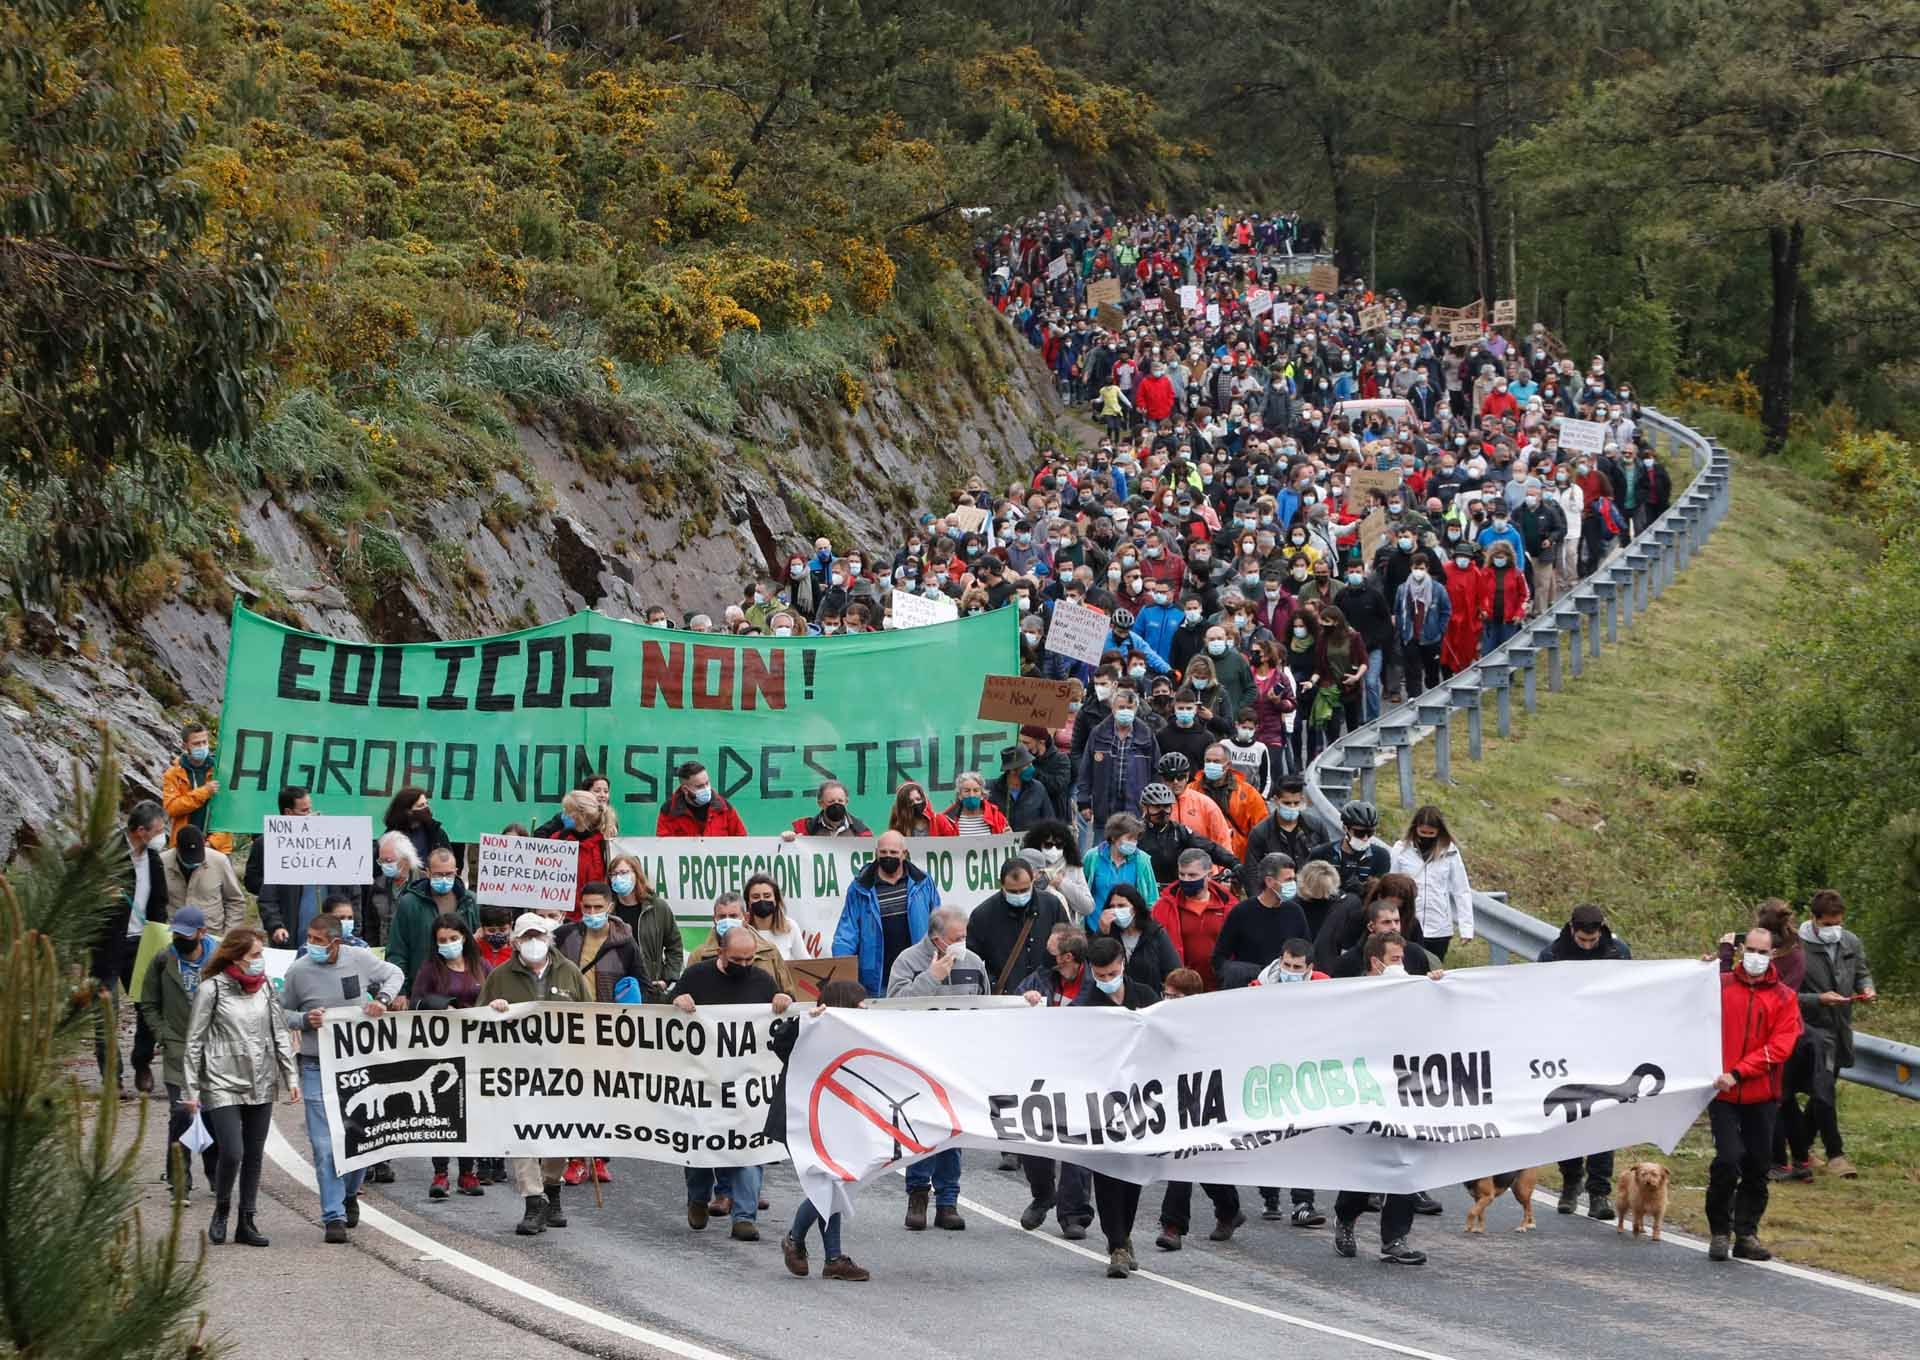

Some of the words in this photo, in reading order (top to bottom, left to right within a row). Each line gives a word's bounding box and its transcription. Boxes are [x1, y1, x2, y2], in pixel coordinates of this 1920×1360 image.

[277, 633, 613, 711] EOLICOS
[1009, 690, 1038, 706] NON
[493, 744, 608, 803] NON
[268, 818, 292, 834] NON
[276, 836, 352, 850] PANDEMIA
[482, 835, 508, 849] NON
[480, 865, 489, 876] A
[535, 856, 562, 868] NON
[814, 853, 840, 898] DA
[926, 850, 953, 892] DO
[540, 886, 571, 902] NON
[332, 1016, 398, 1059] NON
[408, 1015, 450, 1049] AO
[461, 1011, 585, 1046] PARQUE
[595, 1009, 706, 1056] EÓLICO
[717, 1020, 757, 1058] NA
[1529, 1058, 1569, 1080] SOS
[339, 1069, 370, 1089] SOS
[480, 1067, 584, 1097] ESPAZO
[593, 1069, 713, 1108] NATURAL
[721, 1081, 737, 1109] E
[988, 1078, 1167, 1145] EÓLICOS
[1177, 1068, 1228, 1130] NA
[1242, 1056, 1386, 1120] GROBA
[1392, 1050, 1493, 1108] NON!
[385, 1131, 421, 1143] PARQUE
